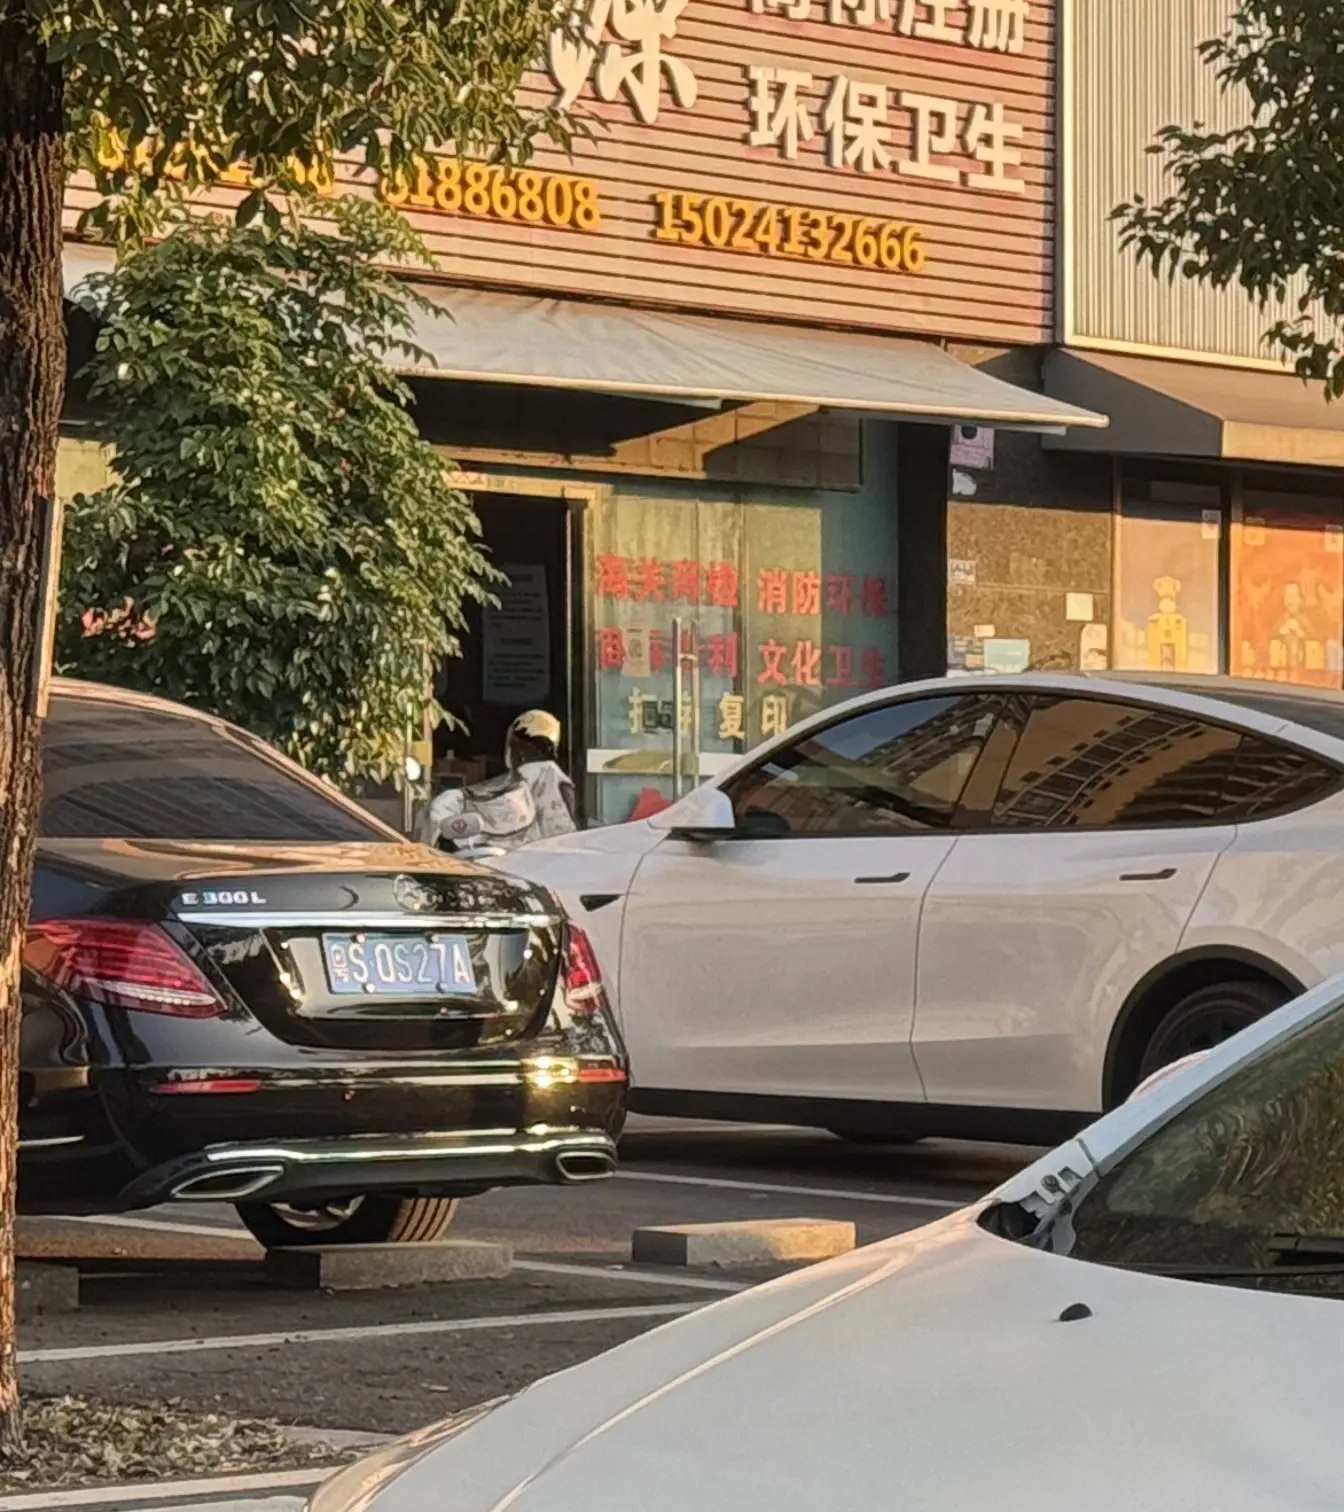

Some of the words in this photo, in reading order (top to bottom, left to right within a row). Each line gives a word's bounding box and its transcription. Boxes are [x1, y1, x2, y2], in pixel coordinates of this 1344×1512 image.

[747, 64, 1026, 194] 环保卫生
[655, 190, 927, 273] 15024132666
[757, 567, 887, 618] 消防环保
[756, 639, 885, 688] 文化卫生
[181, 892, 199, 905] E
